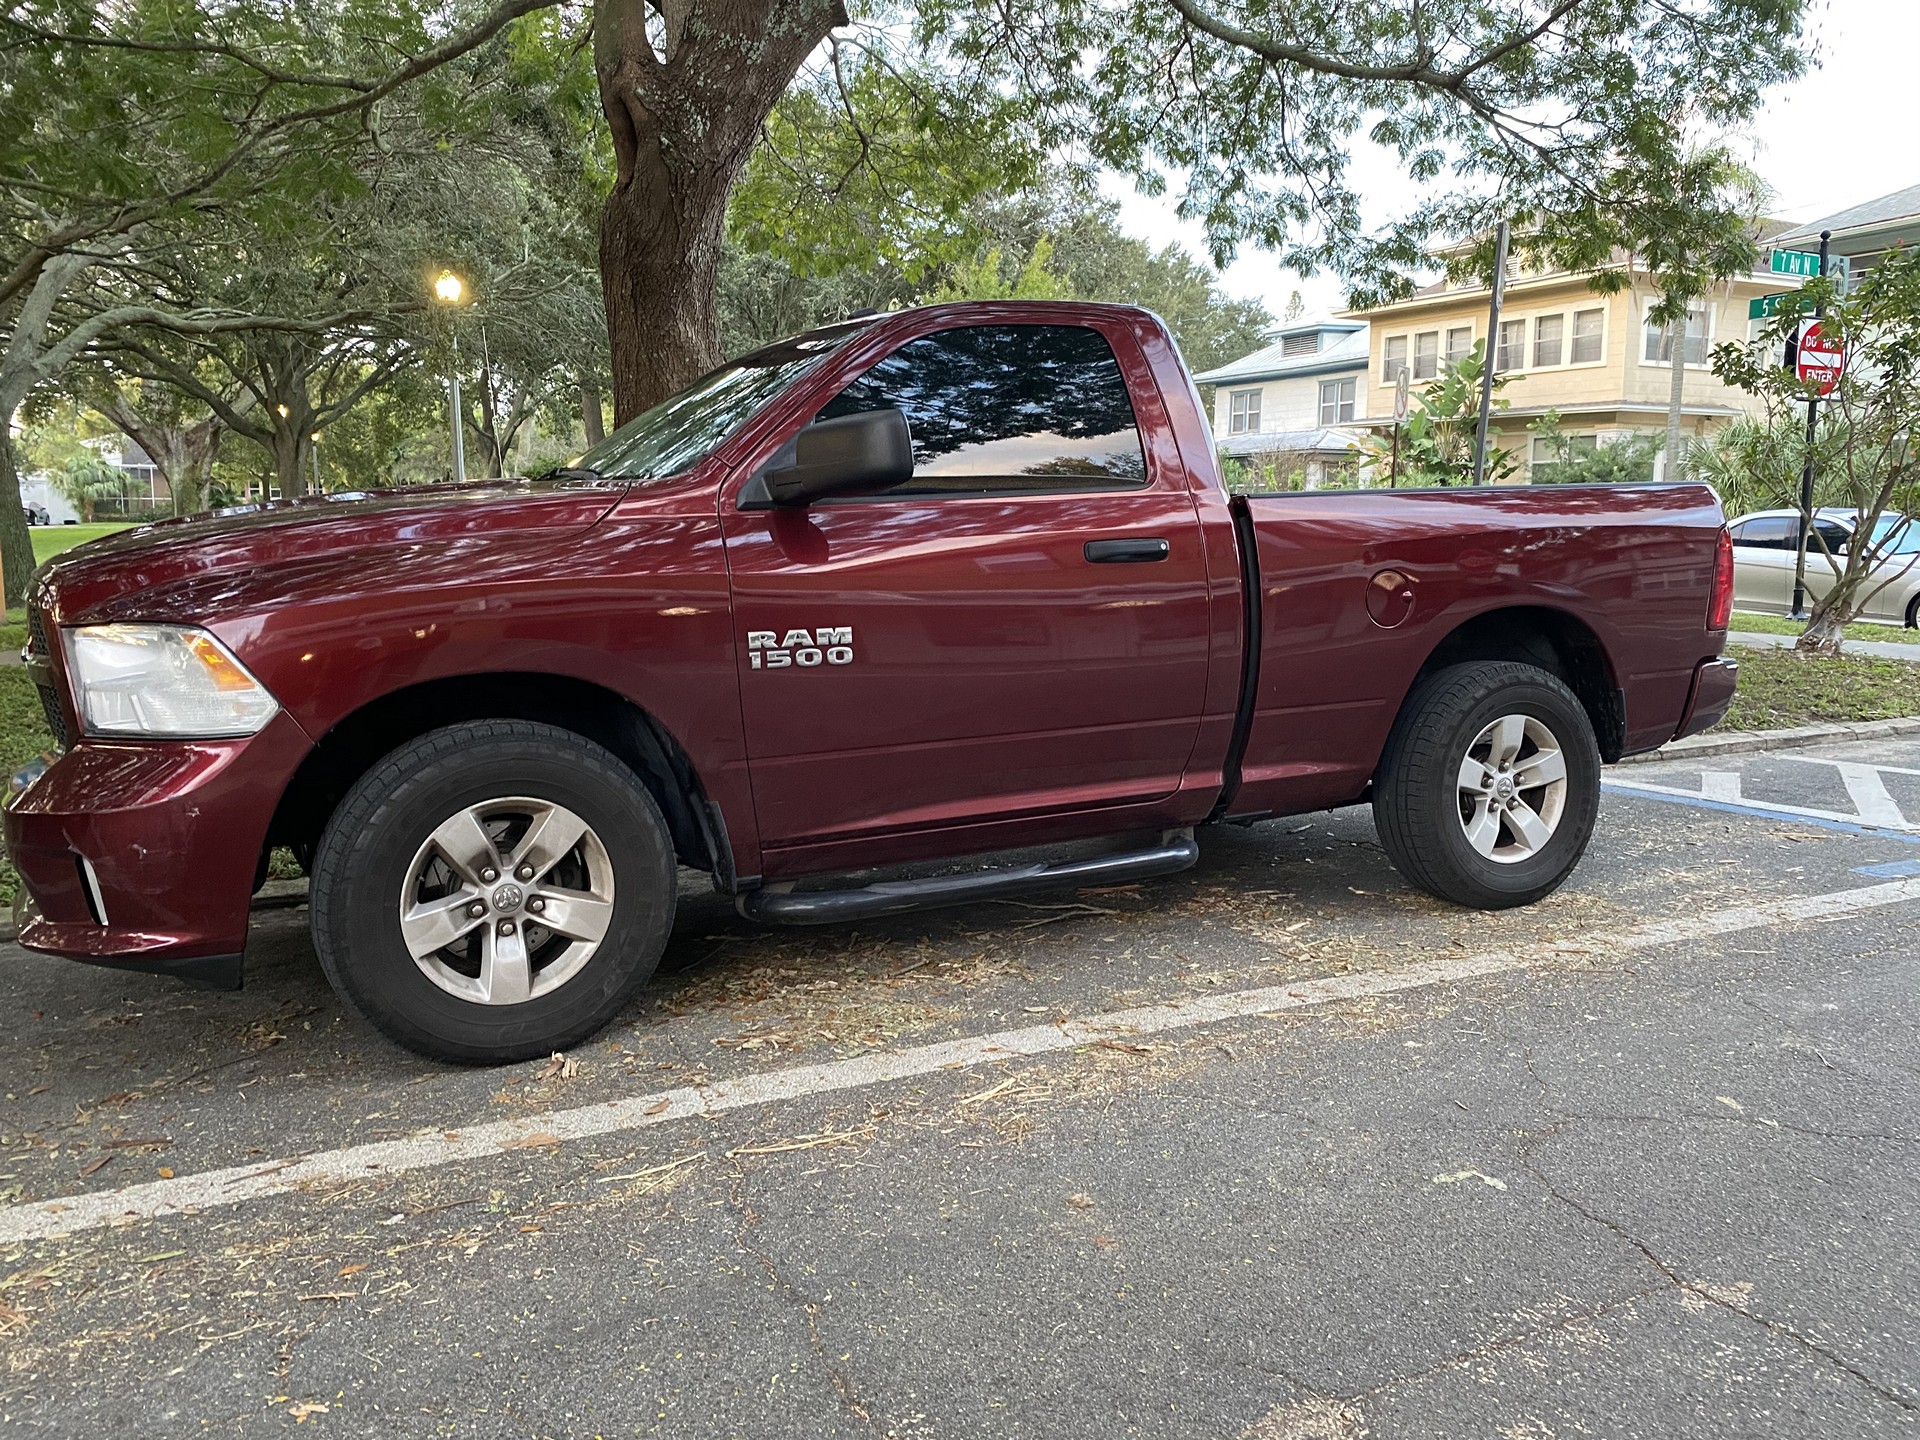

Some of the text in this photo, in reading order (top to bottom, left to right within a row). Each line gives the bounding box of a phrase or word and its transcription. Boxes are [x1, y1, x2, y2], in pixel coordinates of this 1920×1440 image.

[1781, 253, 1810, 274] 7 Av N
[1762, 300, 1769, 317] 5
[1805, 335, 1817, 348] DO
[1806, 369, 1833, 383] ENTER
[747, 626, 853, 649] RAM
[748, 646, 853, 670] 1500
